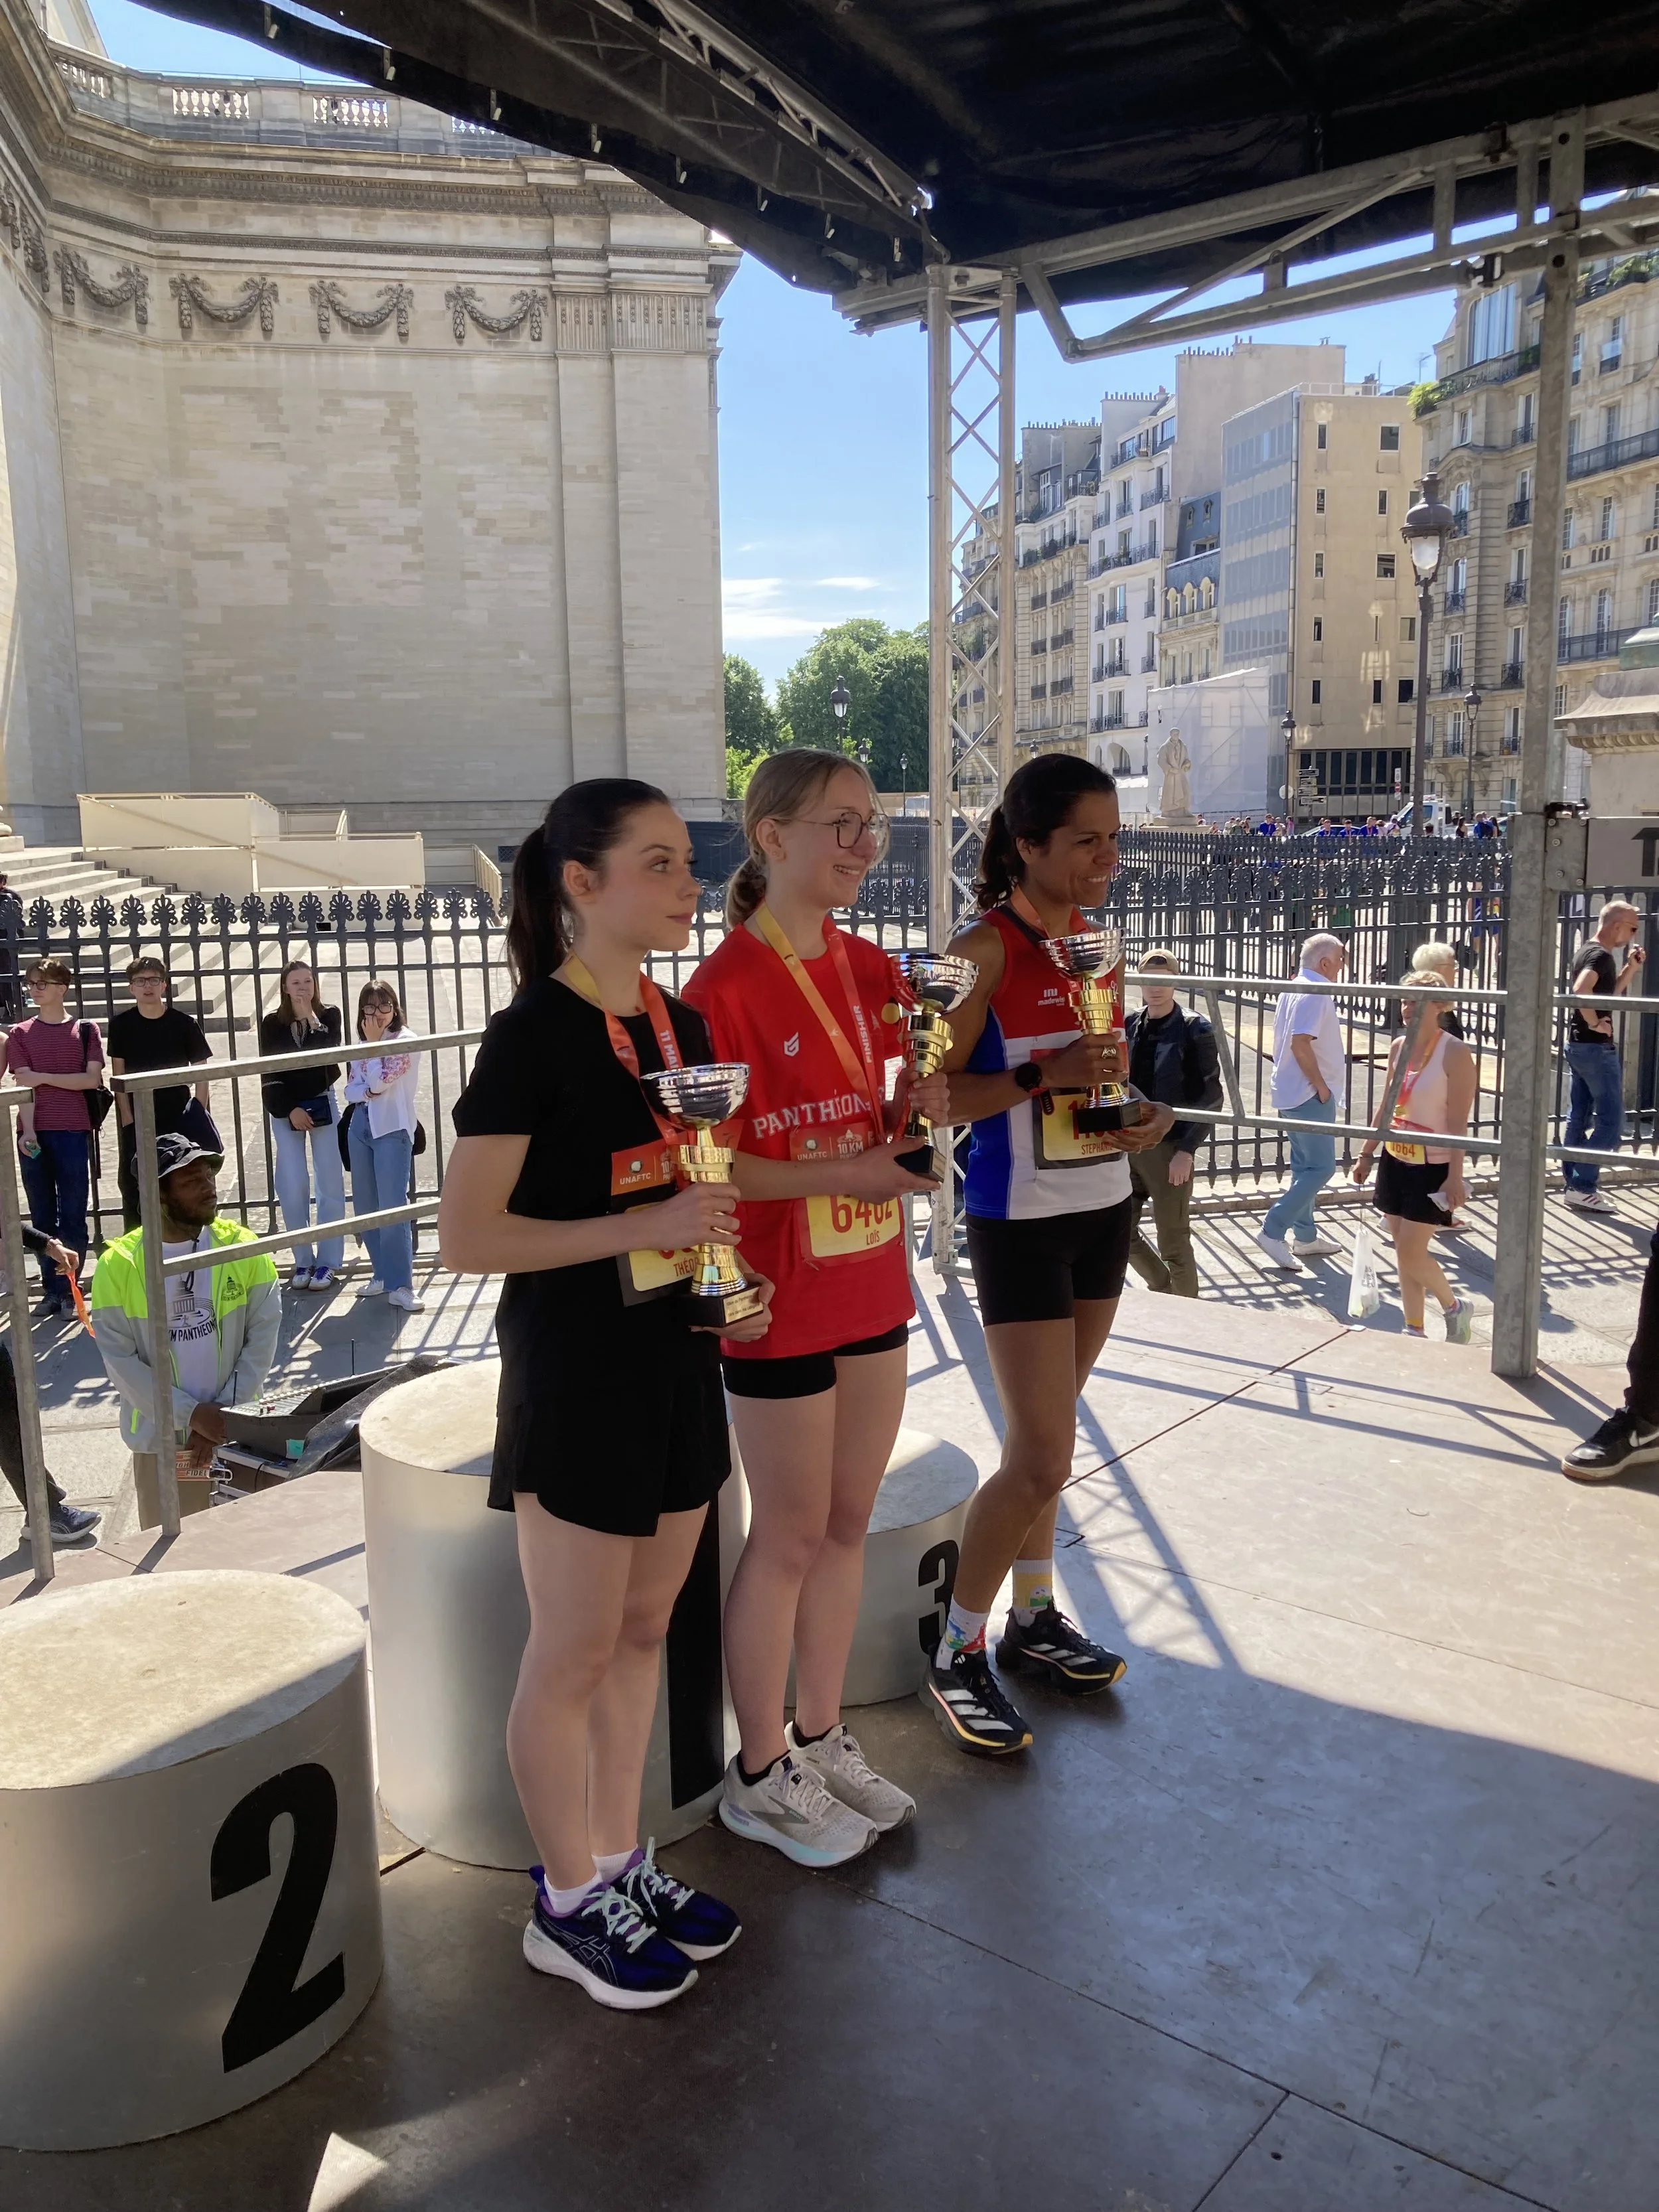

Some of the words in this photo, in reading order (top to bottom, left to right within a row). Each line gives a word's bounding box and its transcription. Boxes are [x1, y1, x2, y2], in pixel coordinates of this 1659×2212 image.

[853, 1005, 872, 1063] FINISHER
[797, 1151, 828, 1161] UNAFTC
[837, 1143, 848, 1154] 10
[849, 1141, 864, 1153] KM
[619, 1172, 651, 1185] UNAFTC
[866, 1229, 880, 1246] LOÏS
[918, 1539, 960, 1656] 3
[210, 1763, 345, 2073] 2
